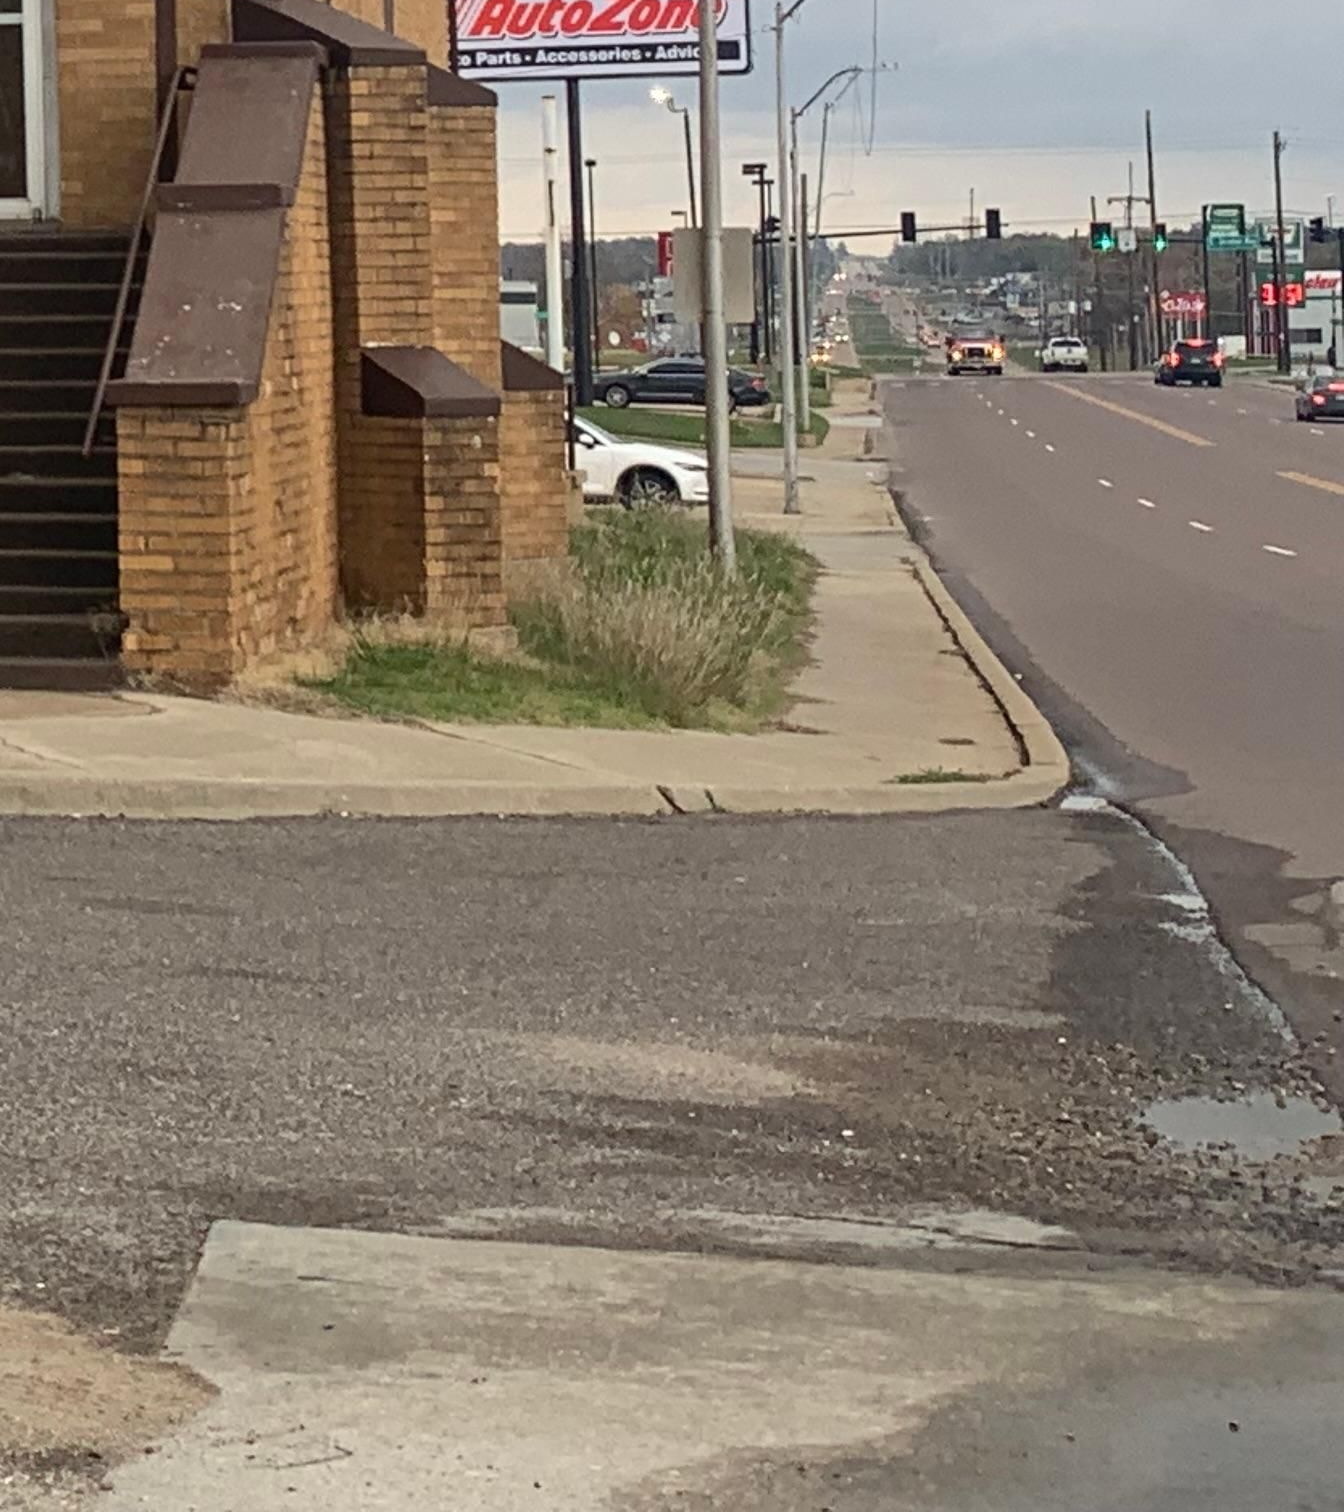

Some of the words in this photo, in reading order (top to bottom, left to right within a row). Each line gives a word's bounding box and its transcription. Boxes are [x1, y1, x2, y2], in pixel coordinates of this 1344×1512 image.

[475, 50, 522, 66] Parts
[535, 45, 642, 64] Accessories
[654, 45, 700, 61] Advic
